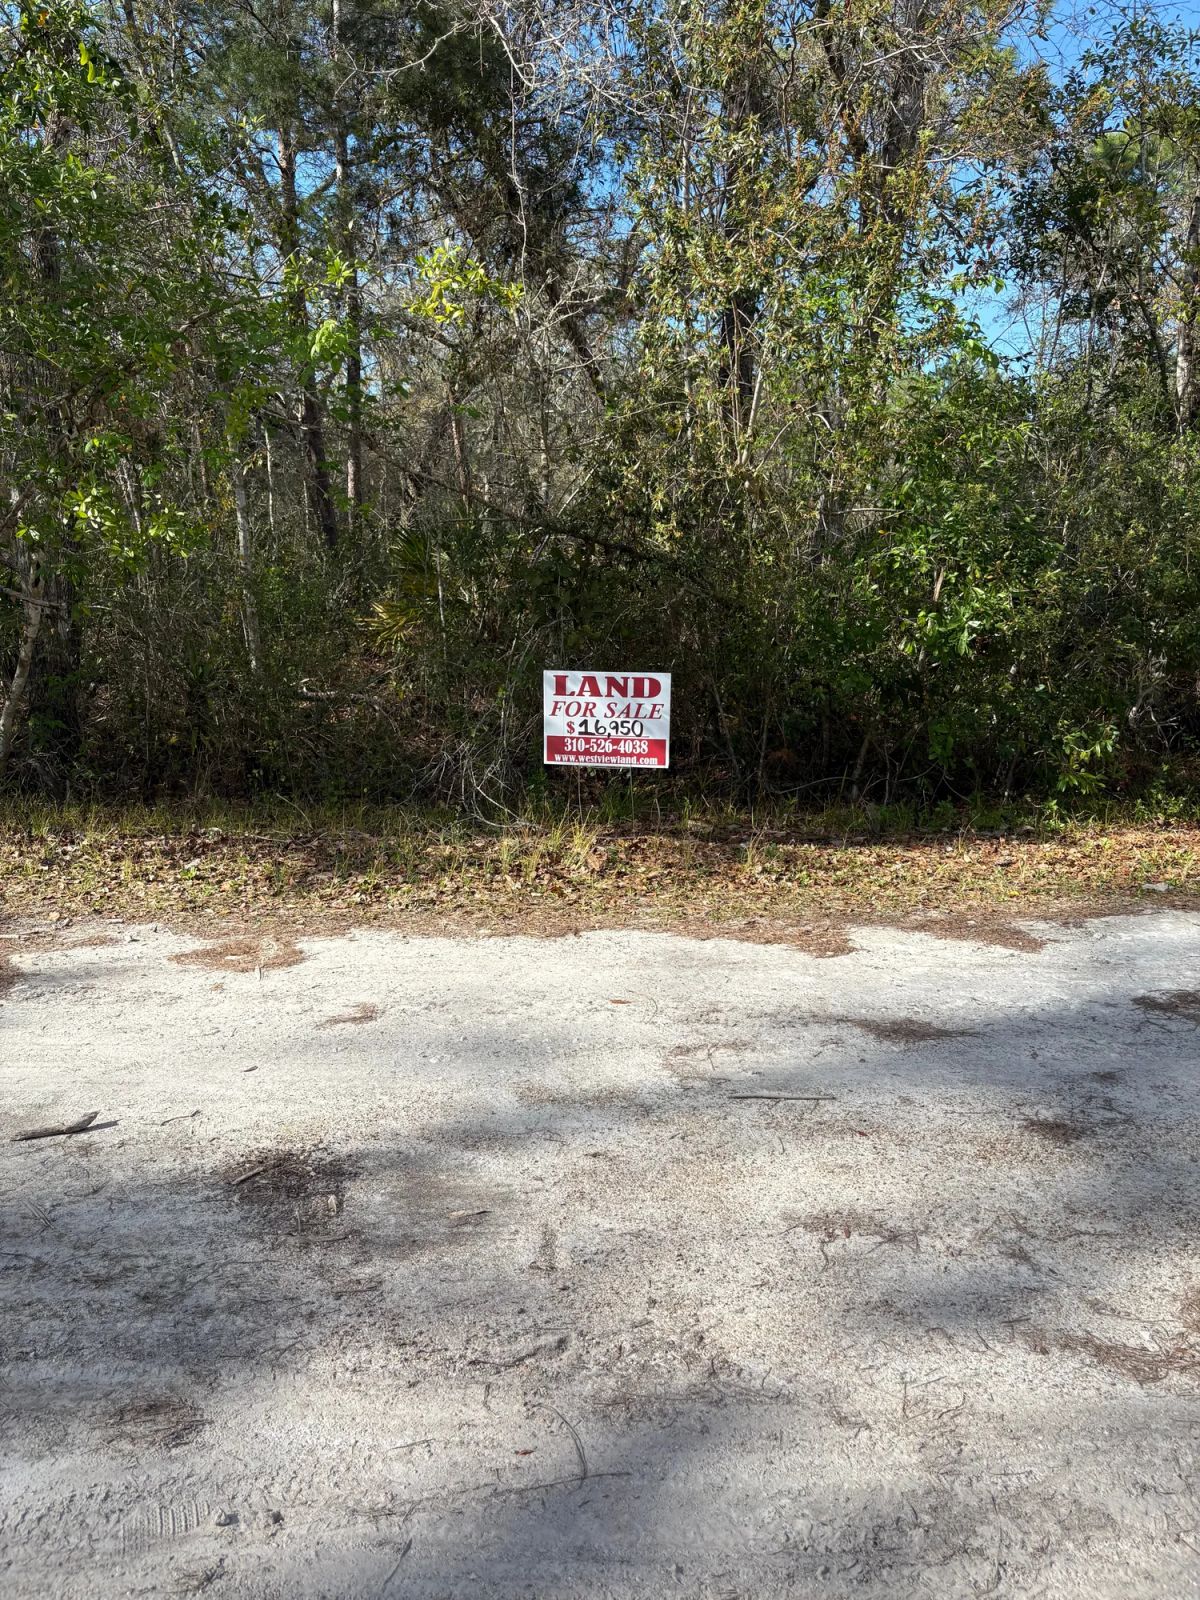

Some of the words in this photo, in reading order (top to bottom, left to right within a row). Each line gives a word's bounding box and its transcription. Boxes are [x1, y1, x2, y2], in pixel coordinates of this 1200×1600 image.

[553, 675, 662, 698] LAND
[549, 701, 597, 718] FOR
[604, 702, 664, 720] SALE
[564, 738, 648, 754] 310-526-4038
[554, 754, 658, 765] www.westviewland.com
